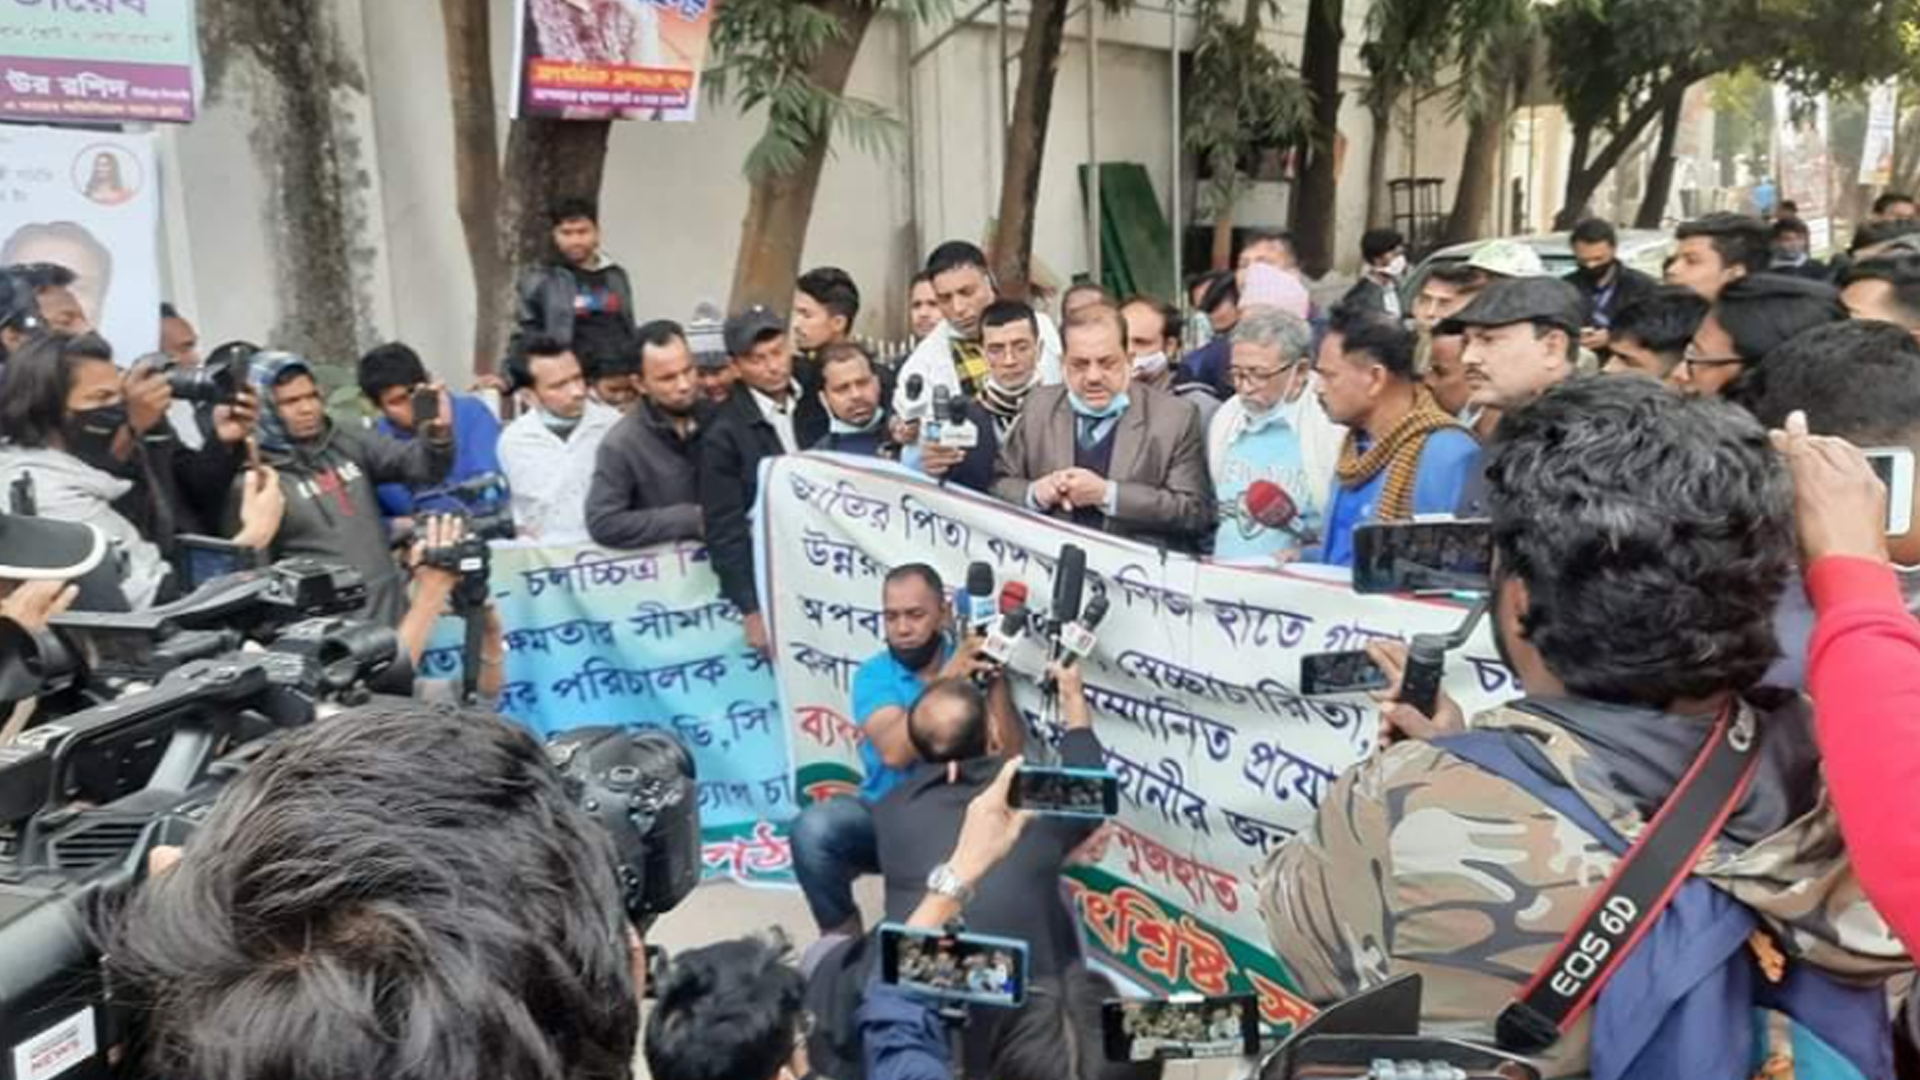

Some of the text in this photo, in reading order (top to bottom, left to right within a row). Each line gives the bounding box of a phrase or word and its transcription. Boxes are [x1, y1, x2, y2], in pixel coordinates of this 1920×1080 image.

[519, 550, 660, 596] চলচ্চিত্র
[800, 525, 889, 578] উন্নয়
[901, 494, 971, 552] পিতা
[1204, 598, 1314, 648] হাতে
[551, 656, 727, 702] পরিচালক
[1242, 741, 1338, 811] প্রযো
[1551, 895, 1639, 997] EOS 6D
